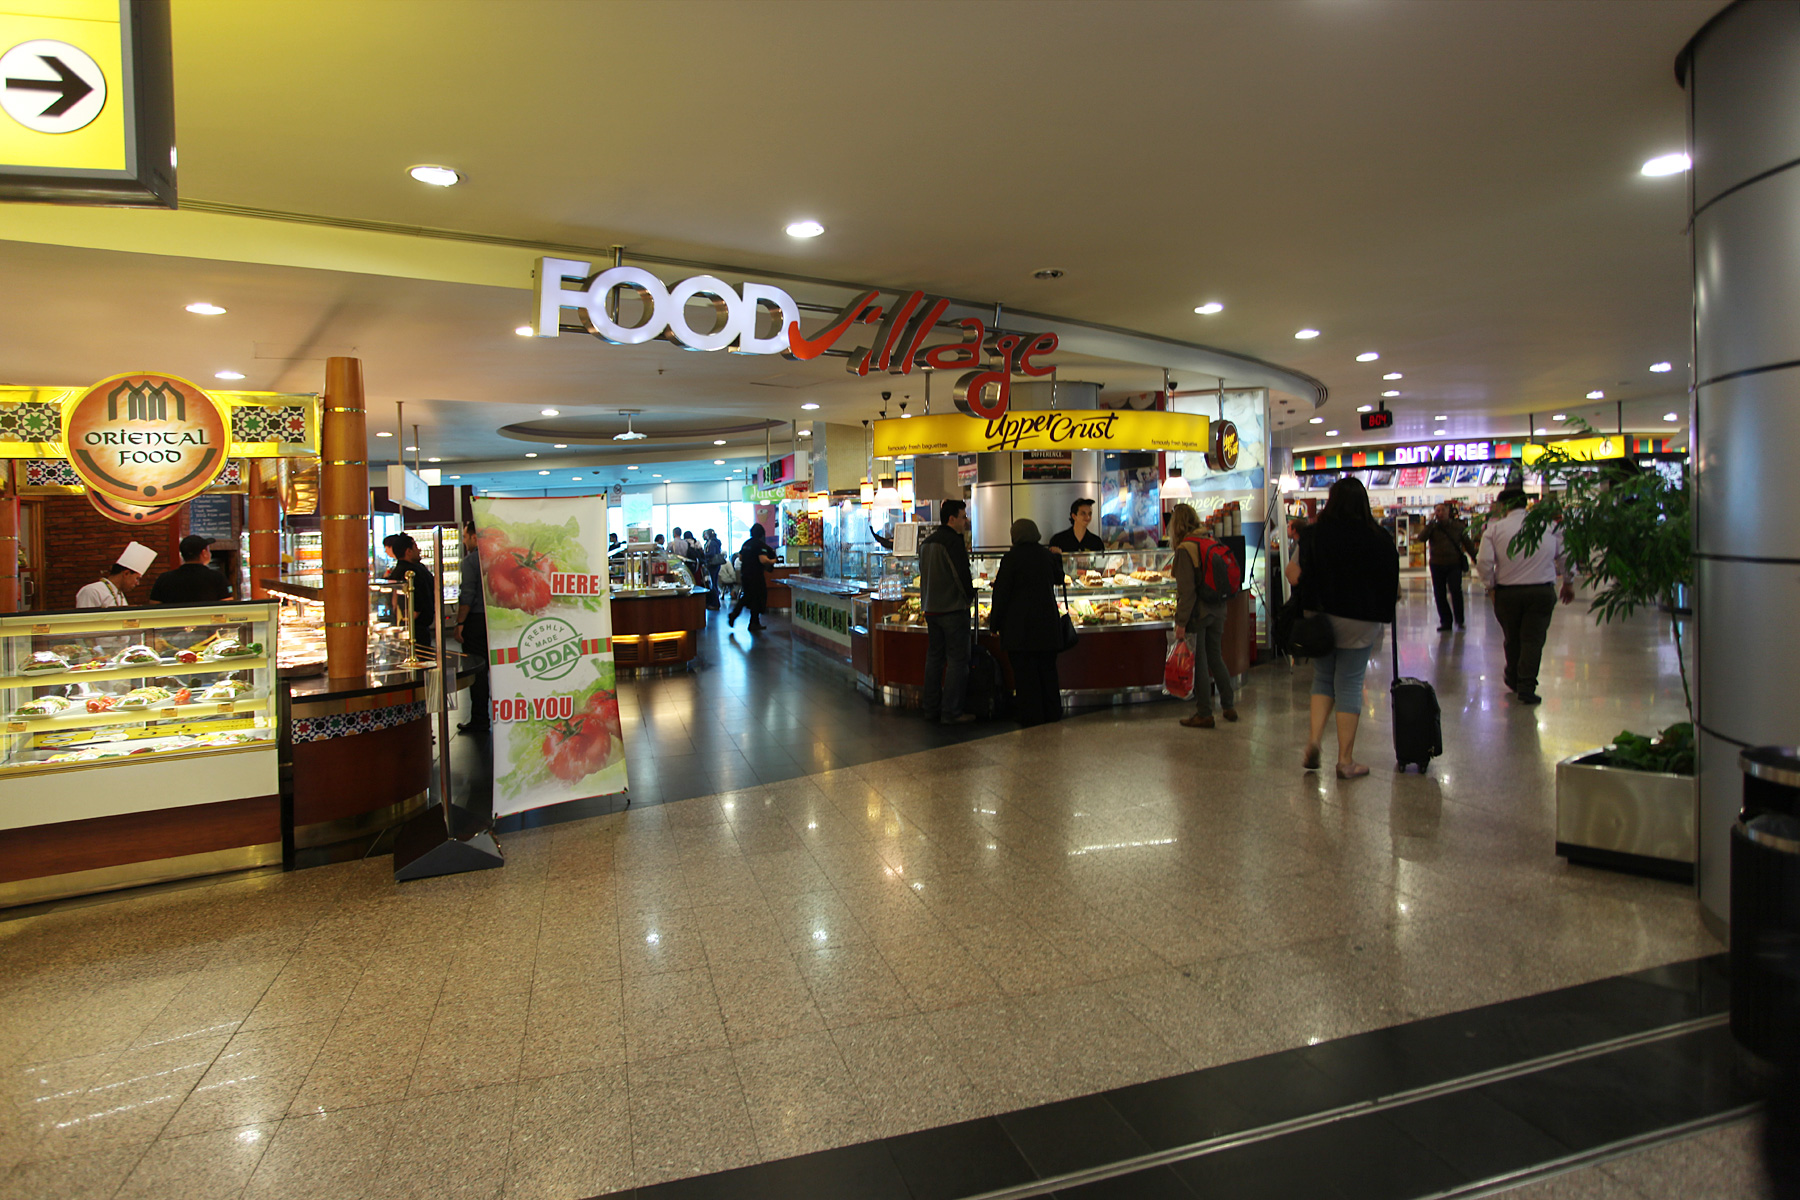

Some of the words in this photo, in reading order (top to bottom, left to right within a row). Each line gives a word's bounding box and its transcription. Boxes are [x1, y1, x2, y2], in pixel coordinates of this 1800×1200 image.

[536, 256, 800, 355] FOOD
[85, 429, 210, 446] ORIENTAL
[985, 413, 1061, 450] Upper
[1050, 412, 1119, 442] Crust
[118, 449, 182, 467] FOOD
[1395, 445, 1440, 464] DUTY
[1445, 442, 1490, 461] FREE
[551, 573, 600, 596] HERE
[524, 624, 565, 647] FRESHLY
[535, 634, 559, 648] MADE
[515, 637, 584, 678] TODAY
[492, 698, 527, 722] FOR
[533, 696, 573, 720] YOU
